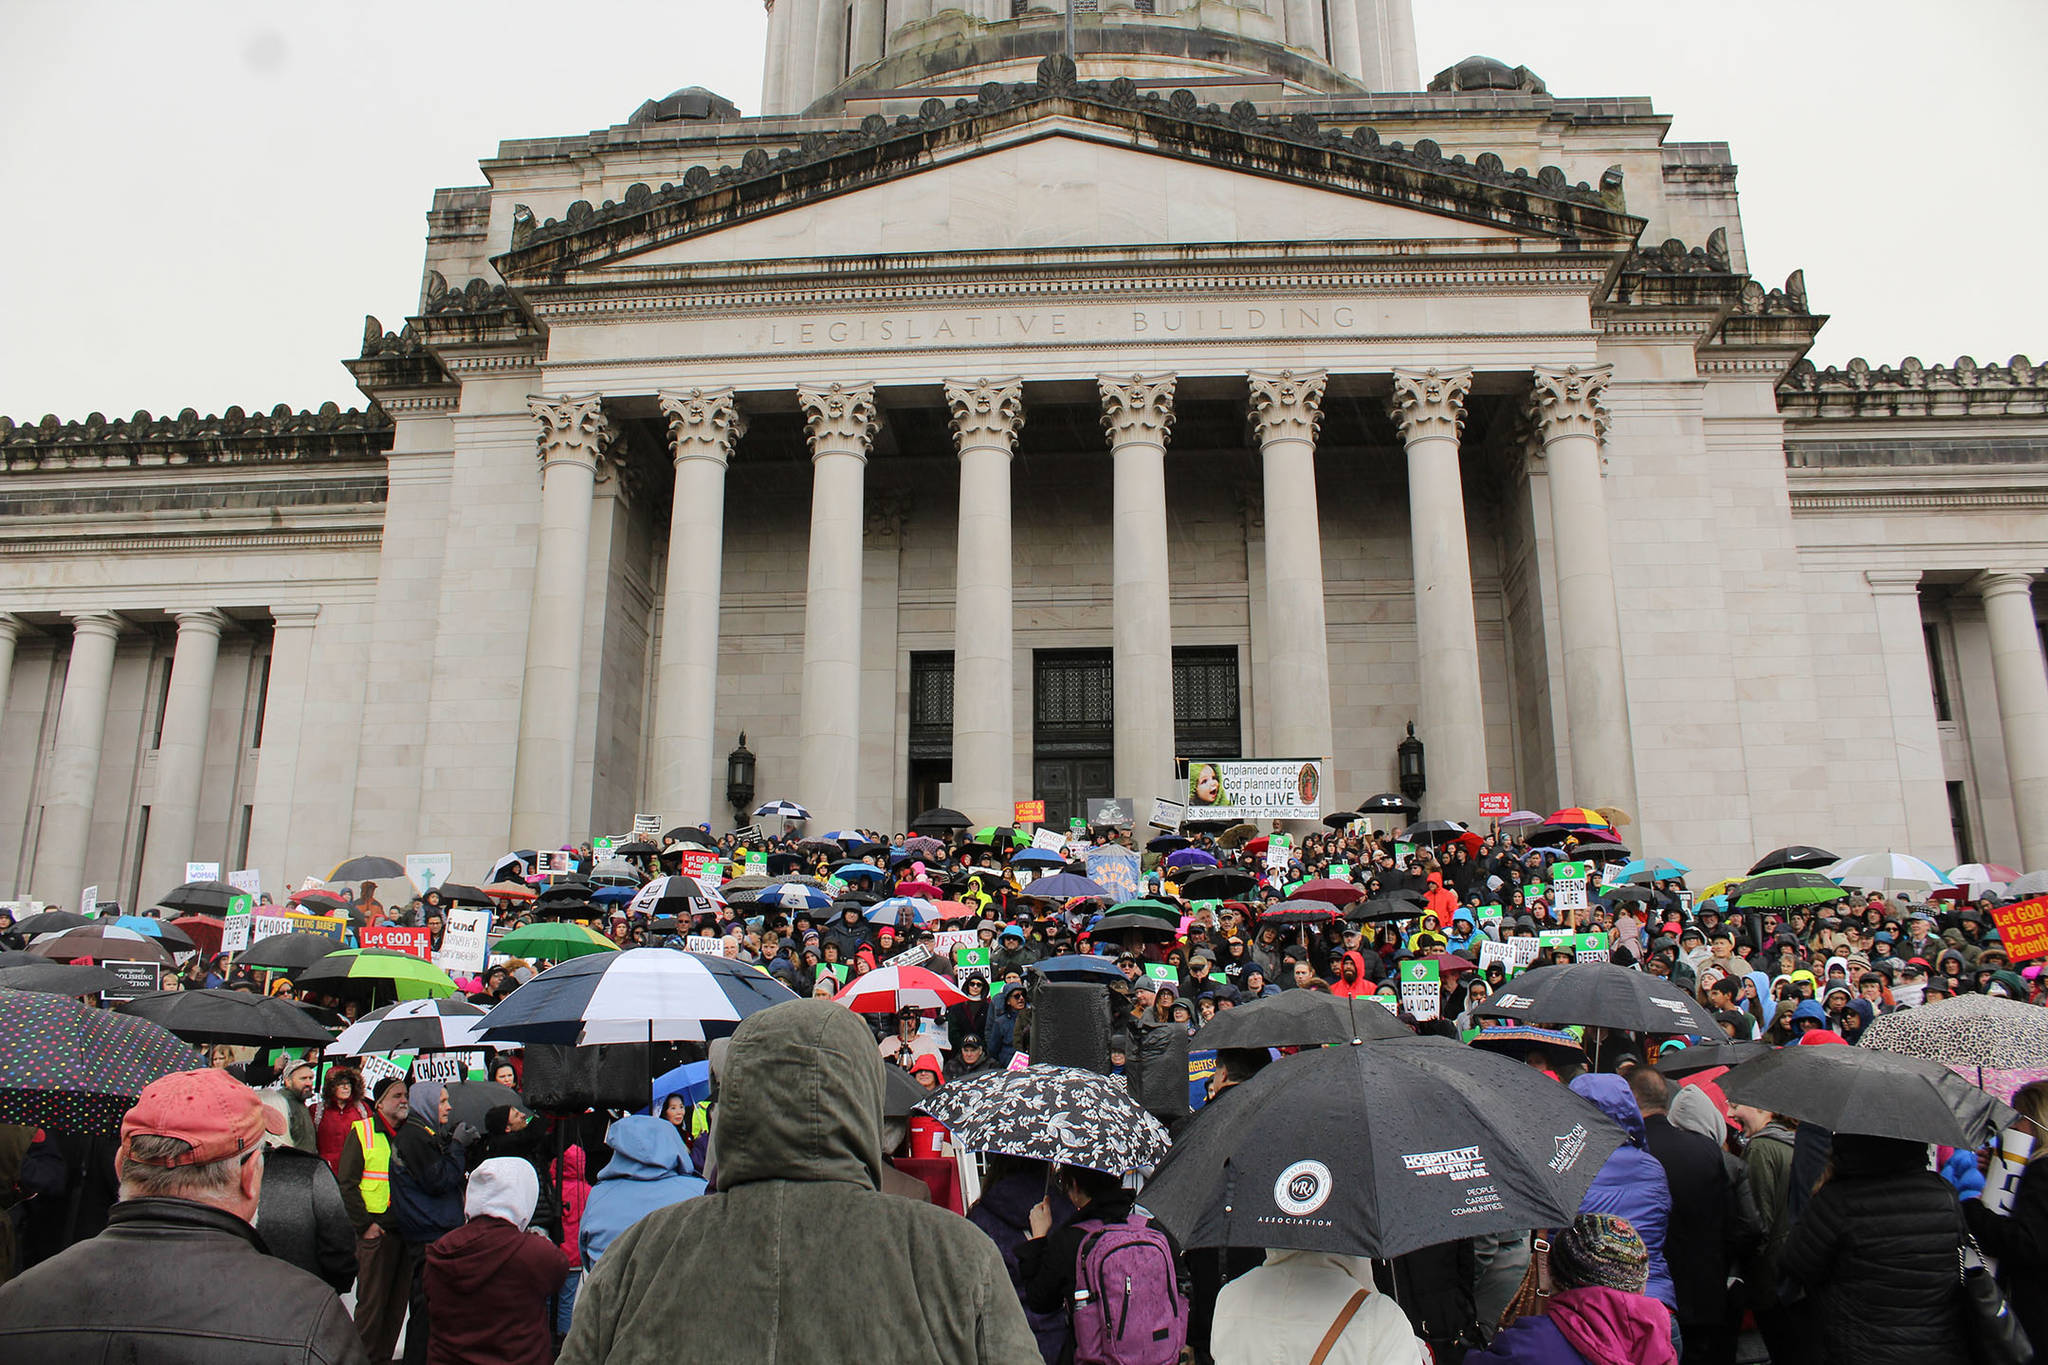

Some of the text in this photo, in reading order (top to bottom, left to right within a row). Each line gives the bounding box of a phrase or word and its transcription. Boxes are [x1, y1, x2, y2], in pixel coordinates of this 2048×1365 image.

[772, 307, 1354, 345] LEGISLATIVE BUILDING
[1222, 764, 1269, 777] Unplanned
[1270, 766, 1280, 775] or
[1223, 777, 1297, 793] God planned for
[1229, 792, 1295, 805] Me to LIVE
[1199, 808, 1227, 819] Stephen
[1228, 808, 1238, 818] the
[1240, 808, 1262, 819] Martyr
[1263, 808, 1292, 818] Catholic
[1293, 808, 1319, 818] Church
[695, 855, 709, 863] GOD
[745, 864, 767, 873] DEFEND
[1605, 864, 1621, 876] CHOO
[1554, 880, 1585, 893] DEFEND
[1562, 894, 1579, 906] LIFE
[1994, 902, 2044, 927] Let GOD
[225, 915, 249, 931] DEFEND
[257, 918, 291, 934] CHOOSE
[227, 931, 241, 945] LIFE
[2007, 922, 2046, 940] Plan
[364, 932, 412, 946] Let GOD
[689, 938, 721, 951] CHOOSE
[935, 933, 974, 948] JESUS
[1483, 942, 1513, 958] CHOOSE
[1514, 952, 1529, 965] LIFE
[1577, 951, 1608, 964] DEFEND
[1402, 983, 1439, 996] DEFIENDE
[1406, 1001, 1415, 1012] LA
[1416, 1000, 1436, 1012] VIDA
[366, 1055, 404, 1081] DEFEND
[417, 1060, 456, 1080] CHOOSE
[1547, 1122, 1585, 1170] WASHINGTON
[1402, 1147, 1480, 1167] HOSPITALITY
[1424, 1161, 1473, 1175] INDUSTRY
[1449, 1168, 1490, 1181] SERVES.
[1291, 1181, 1314, 1197] WRA
[1257, 1216, 1333, 1228] ASSOCIATION
